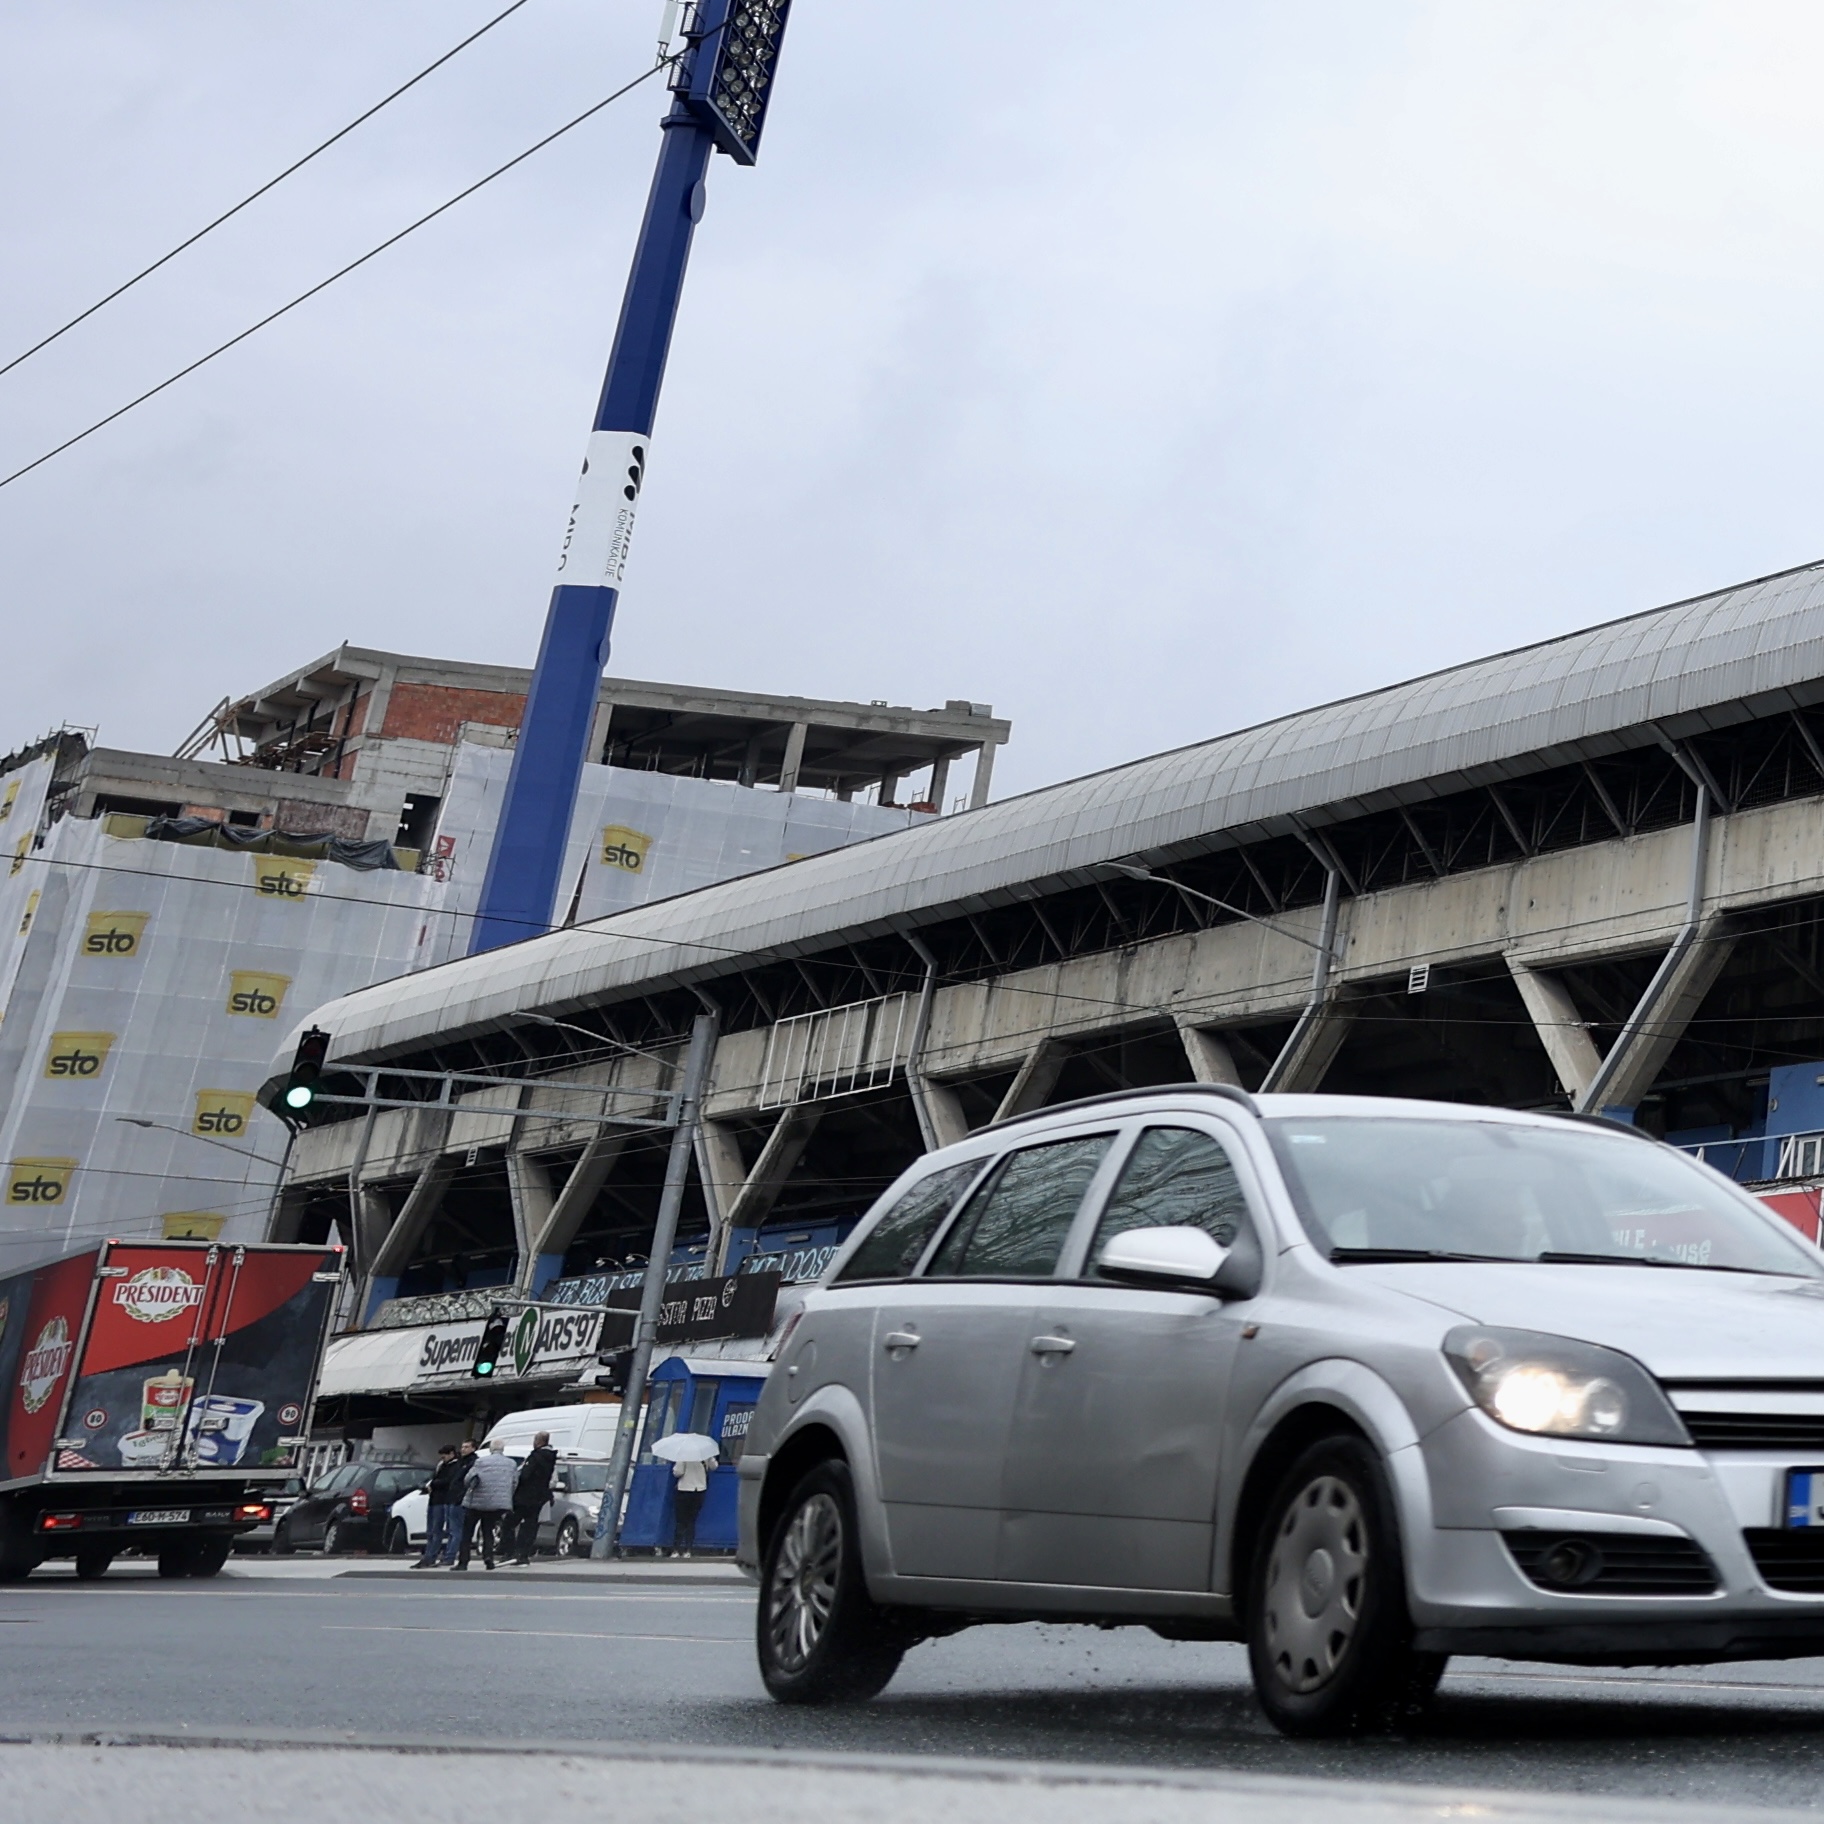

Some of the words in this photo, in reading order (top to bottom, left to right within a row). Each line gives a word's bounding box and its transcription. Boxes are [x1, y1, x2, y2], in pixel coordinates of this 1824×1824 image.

[604, 508, 629, 579] KOMUNIKACIJE
[604, 842, 641, 869] sto
[260, 870, 303, 897] sto
[87, 927, 135, 953] sto
[231, 988, 276, 1014] sto
[50, 1049, 99, 1075] sto
[198, 1107, 242, 1133] sto
[12, 1174, 62, 1202] sto
[115, 1283, 203, 1305] PRÉSIDENT
[691, 1295, 718, 1322] PIZZA
[91, 1413, 102, 1425] 80
[284, 1408, 296, 1420] 90
